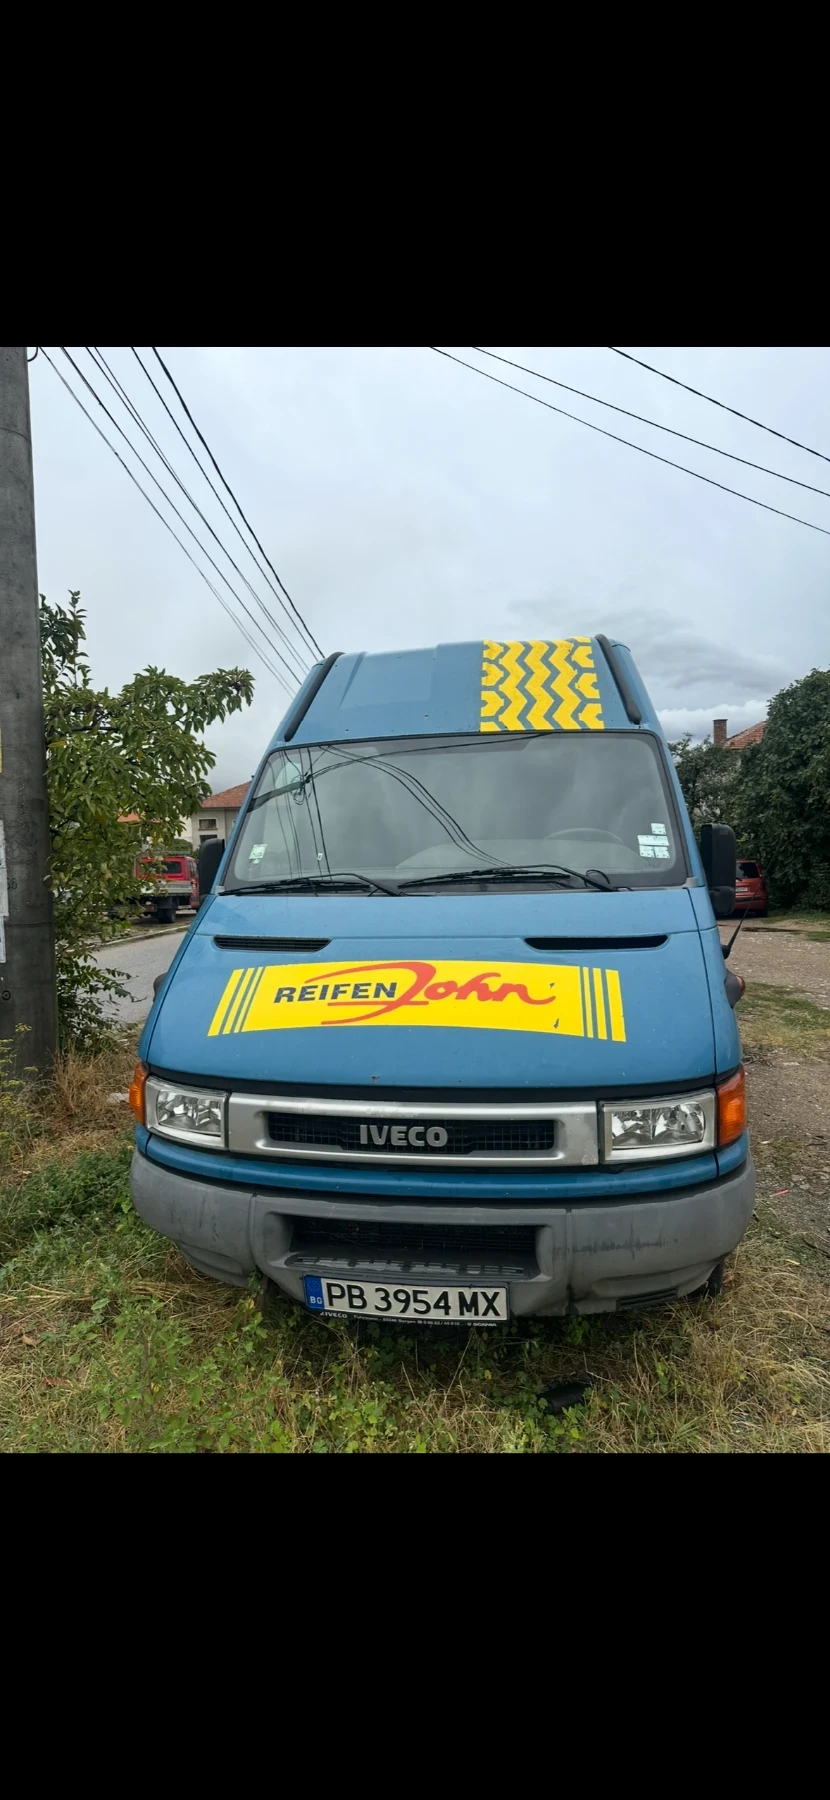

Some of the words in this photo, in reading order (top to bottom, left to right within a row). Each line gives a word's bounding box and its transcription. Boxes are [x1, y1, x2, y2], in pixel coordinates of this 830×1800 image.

[273, 981, 398, 1004] REIFEN
[359, 1124, 448, 1147] IVECO
[310, 1296, 323, 1305] BG
[326, 1282, 367, 1309] PB
[374, 1287, 451, 1315] 3954
[458, 1291, 501, 1317] MX
